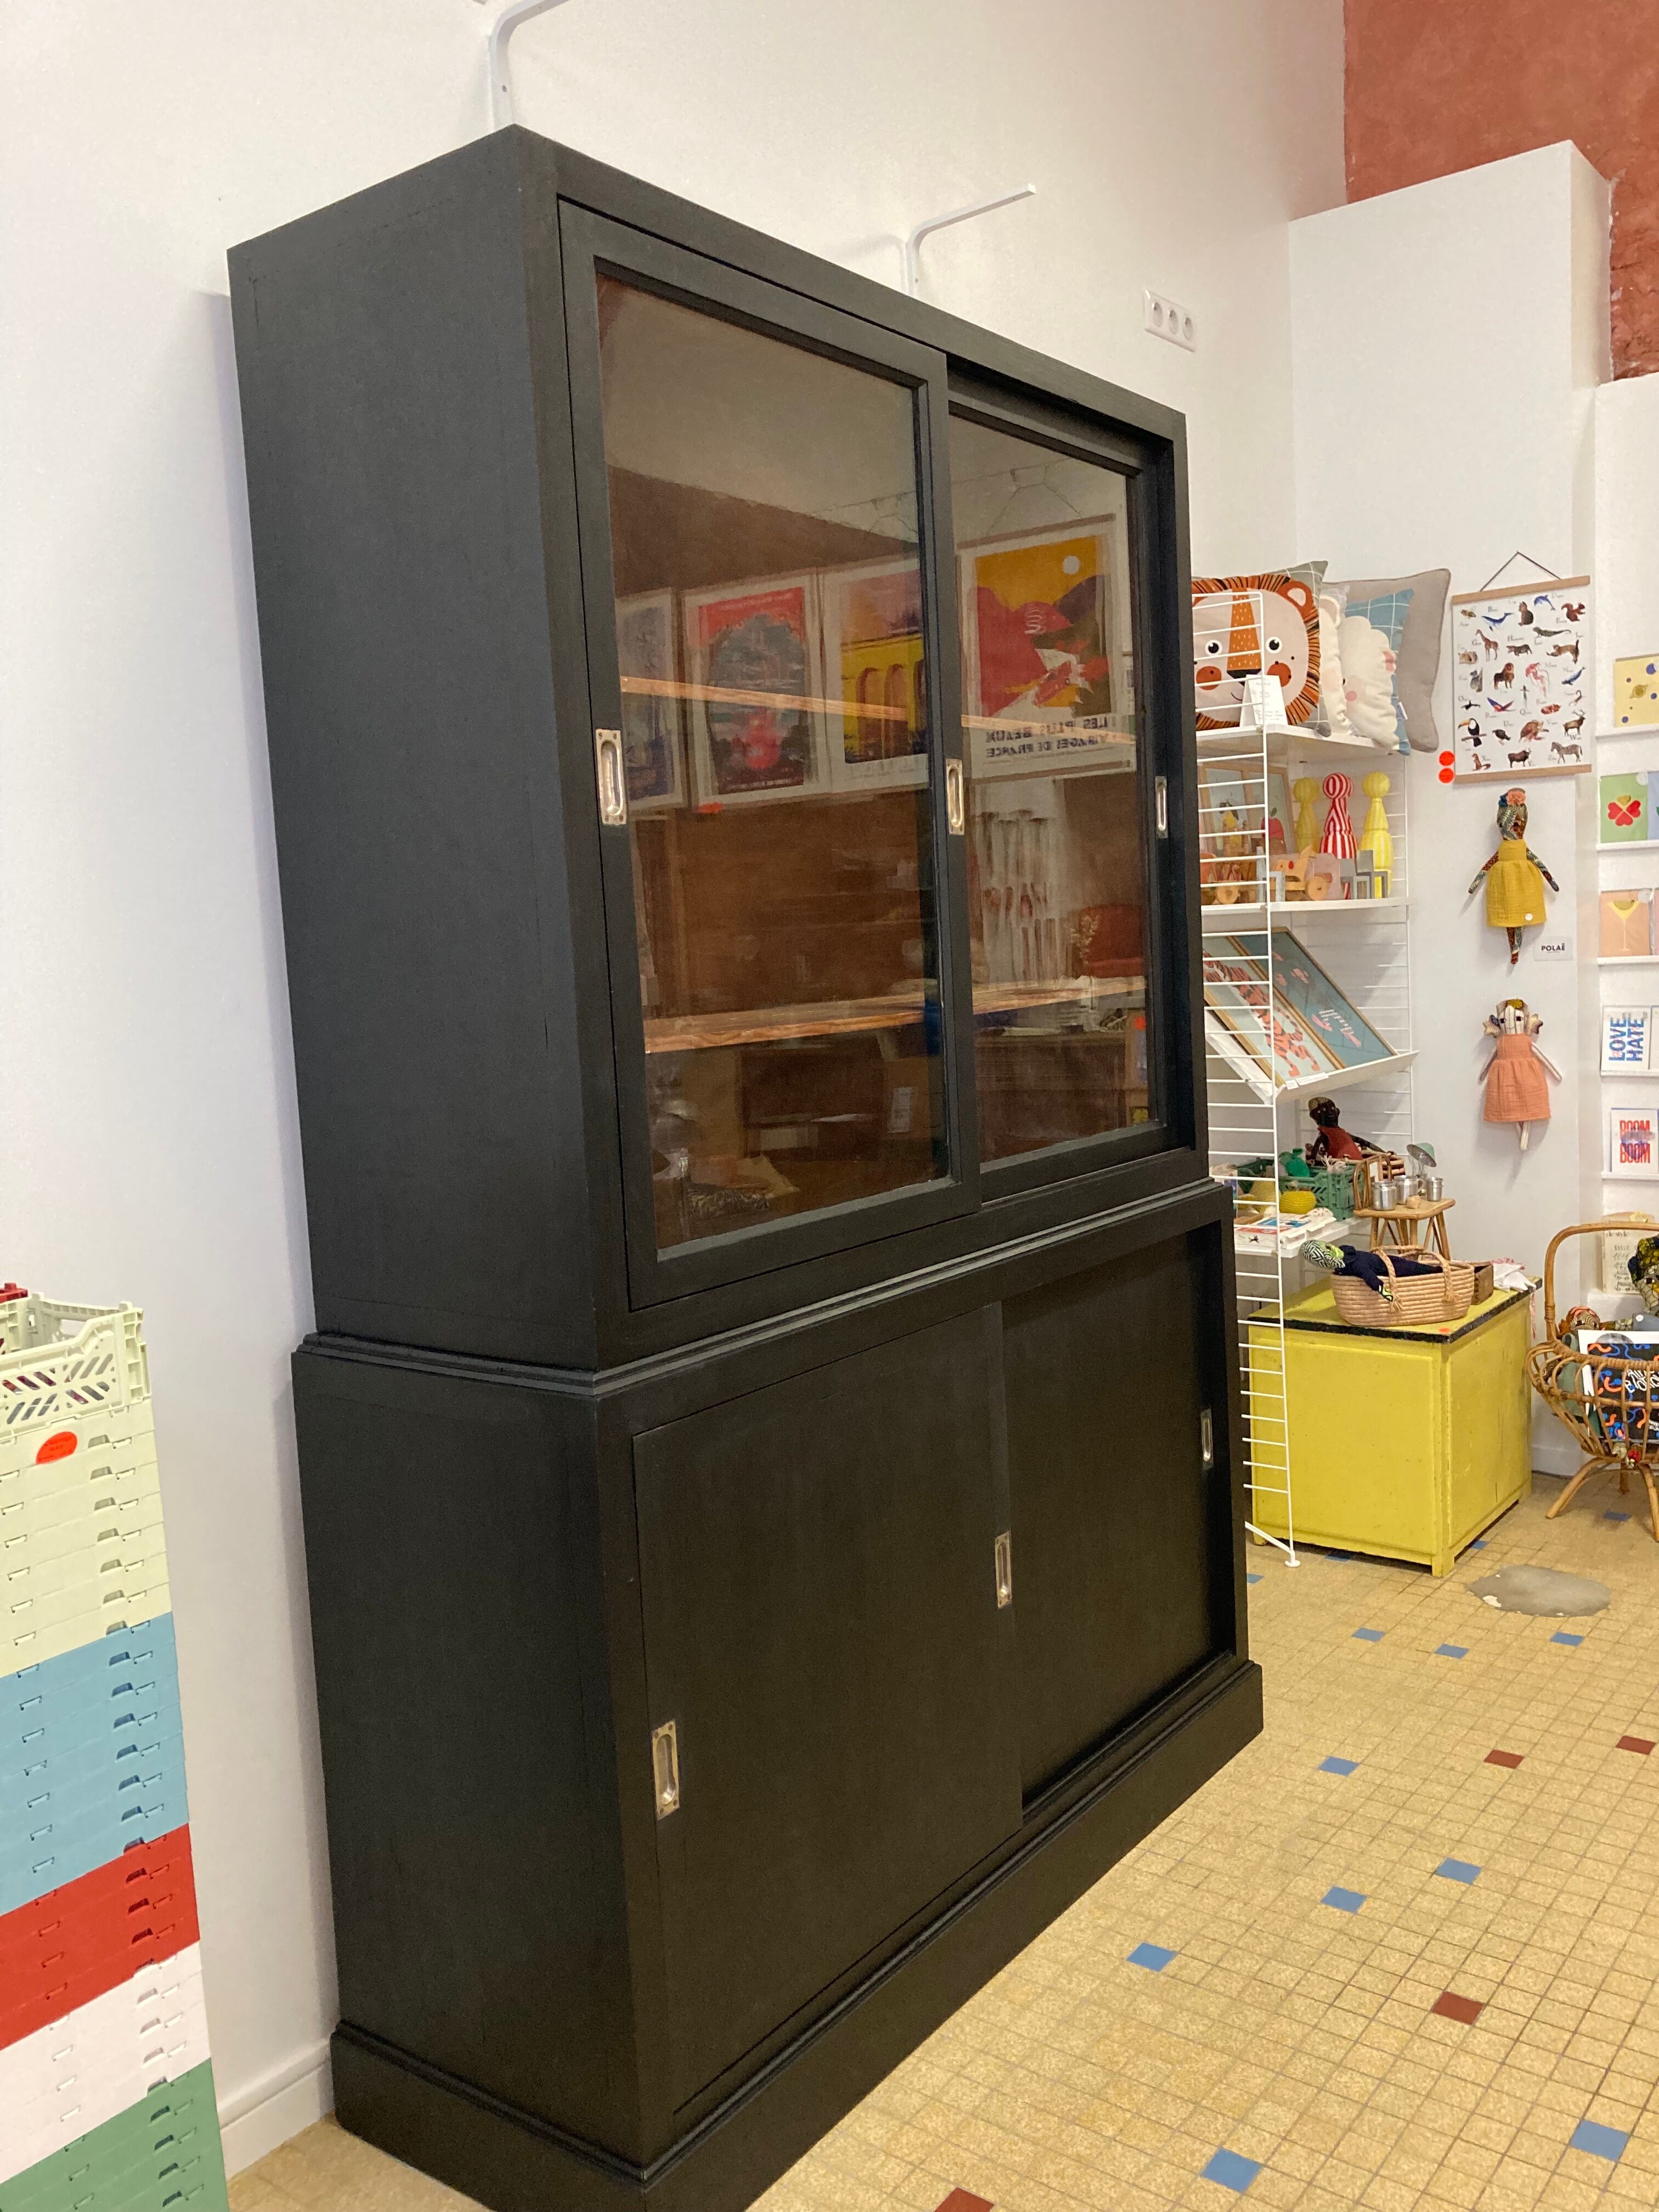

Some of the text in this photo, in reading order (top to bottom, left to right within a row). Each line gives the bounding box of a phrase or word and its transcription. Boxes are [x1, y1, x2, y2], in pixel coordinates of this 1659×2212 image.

[1609, 1018, 1627, 1062] LOVE
[1626, 1018, 1645, 1062] HATE
[1620, 1143, 1651, 1164] BOOM
